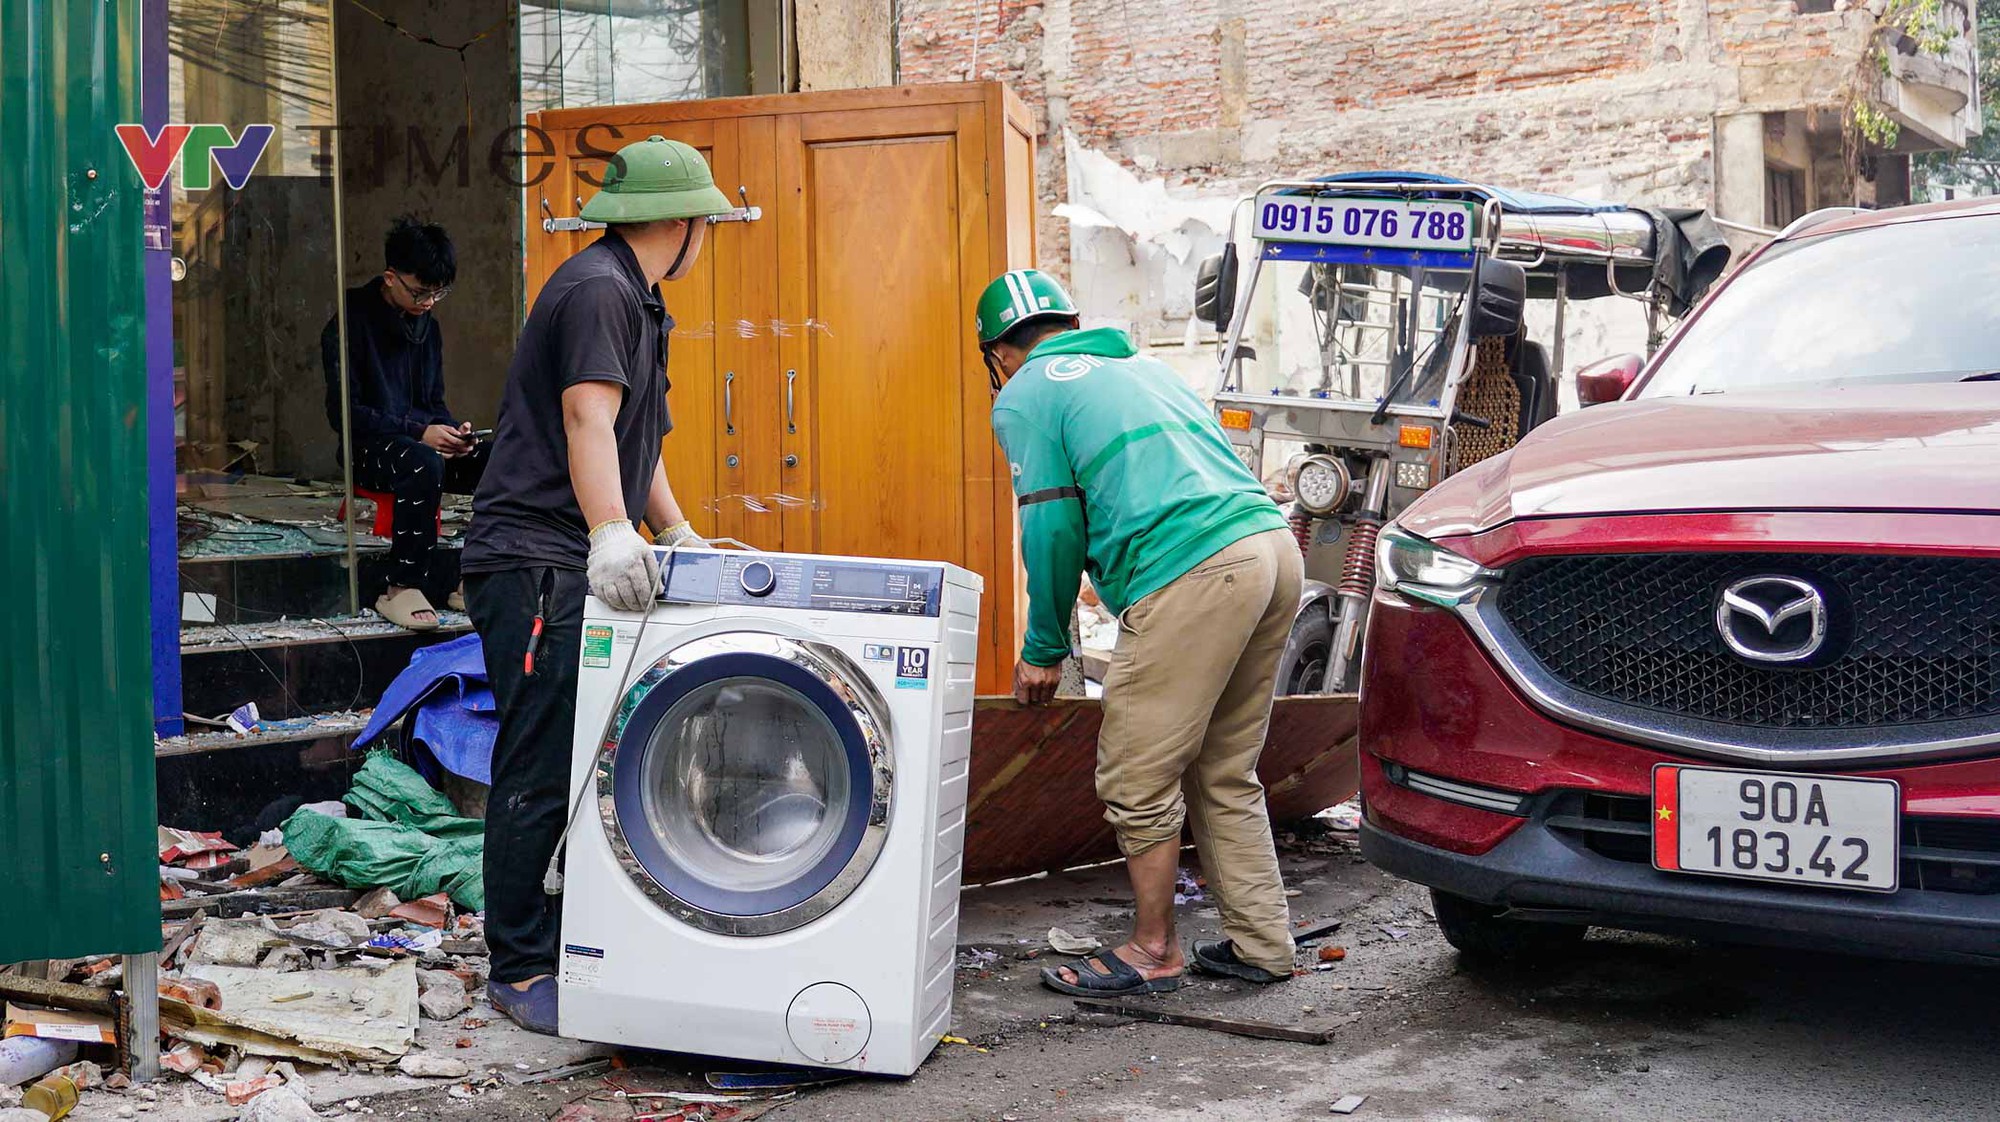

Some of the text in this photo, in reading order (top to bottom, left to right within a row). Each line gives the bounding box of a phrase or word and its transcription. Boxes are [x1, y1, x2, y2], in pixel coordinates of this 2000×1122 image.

[1262, 203, 1465, 241] 0915 076 788
[902, 648, 925, 668] 10
[902, 666, 923, 674] YEAR
[1739, 779, 1830, 827] 90A
[1707, 826, 1870, 882] 183.42
